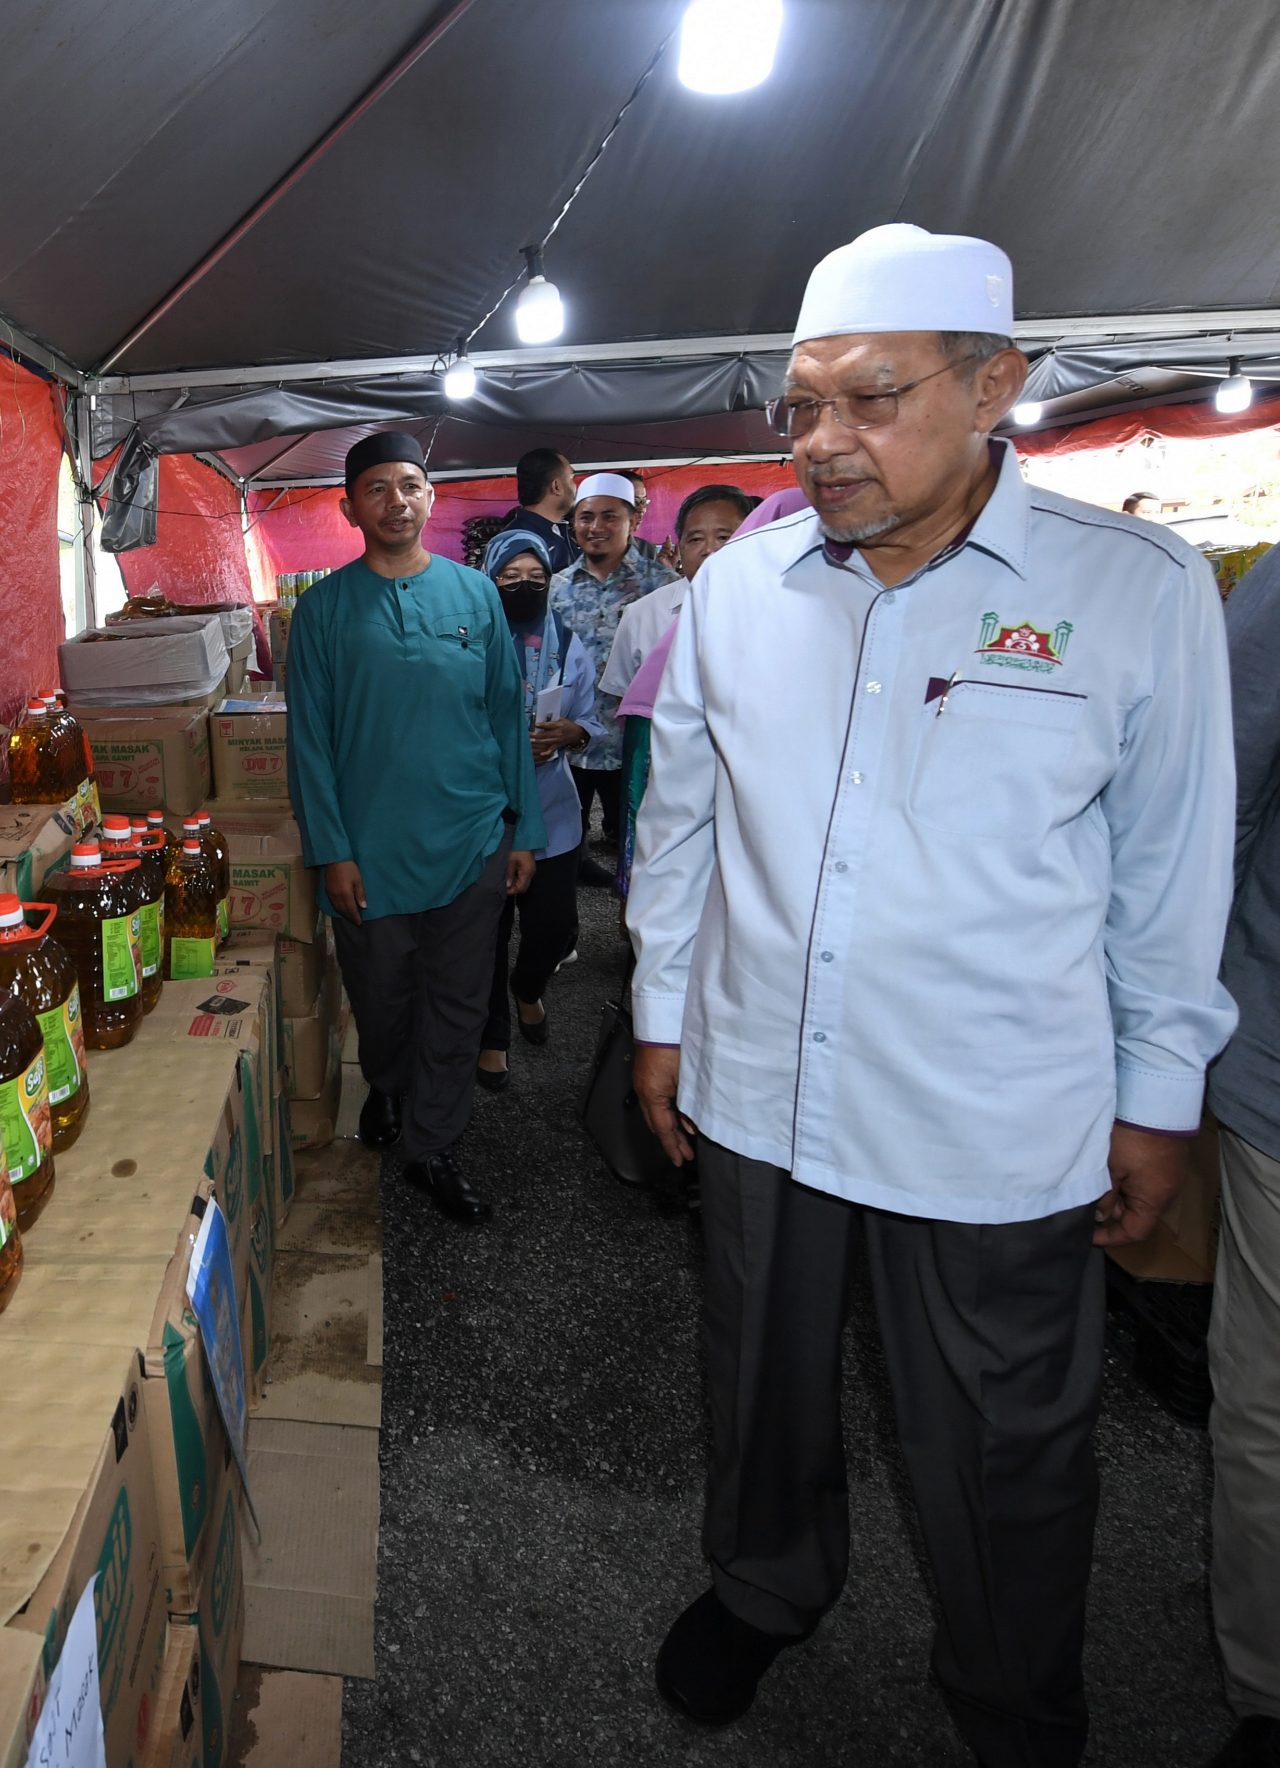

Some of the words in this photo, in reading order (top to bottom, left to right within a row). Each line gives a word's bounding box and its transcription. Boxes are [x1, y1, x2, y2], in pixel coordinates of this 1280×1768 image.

[265, 736, 287, 745] MASA
[111, 744, 150, 754] MASAK
[120, 770, 133, 788] 7
[232, 869, 276, 878] MASAK
